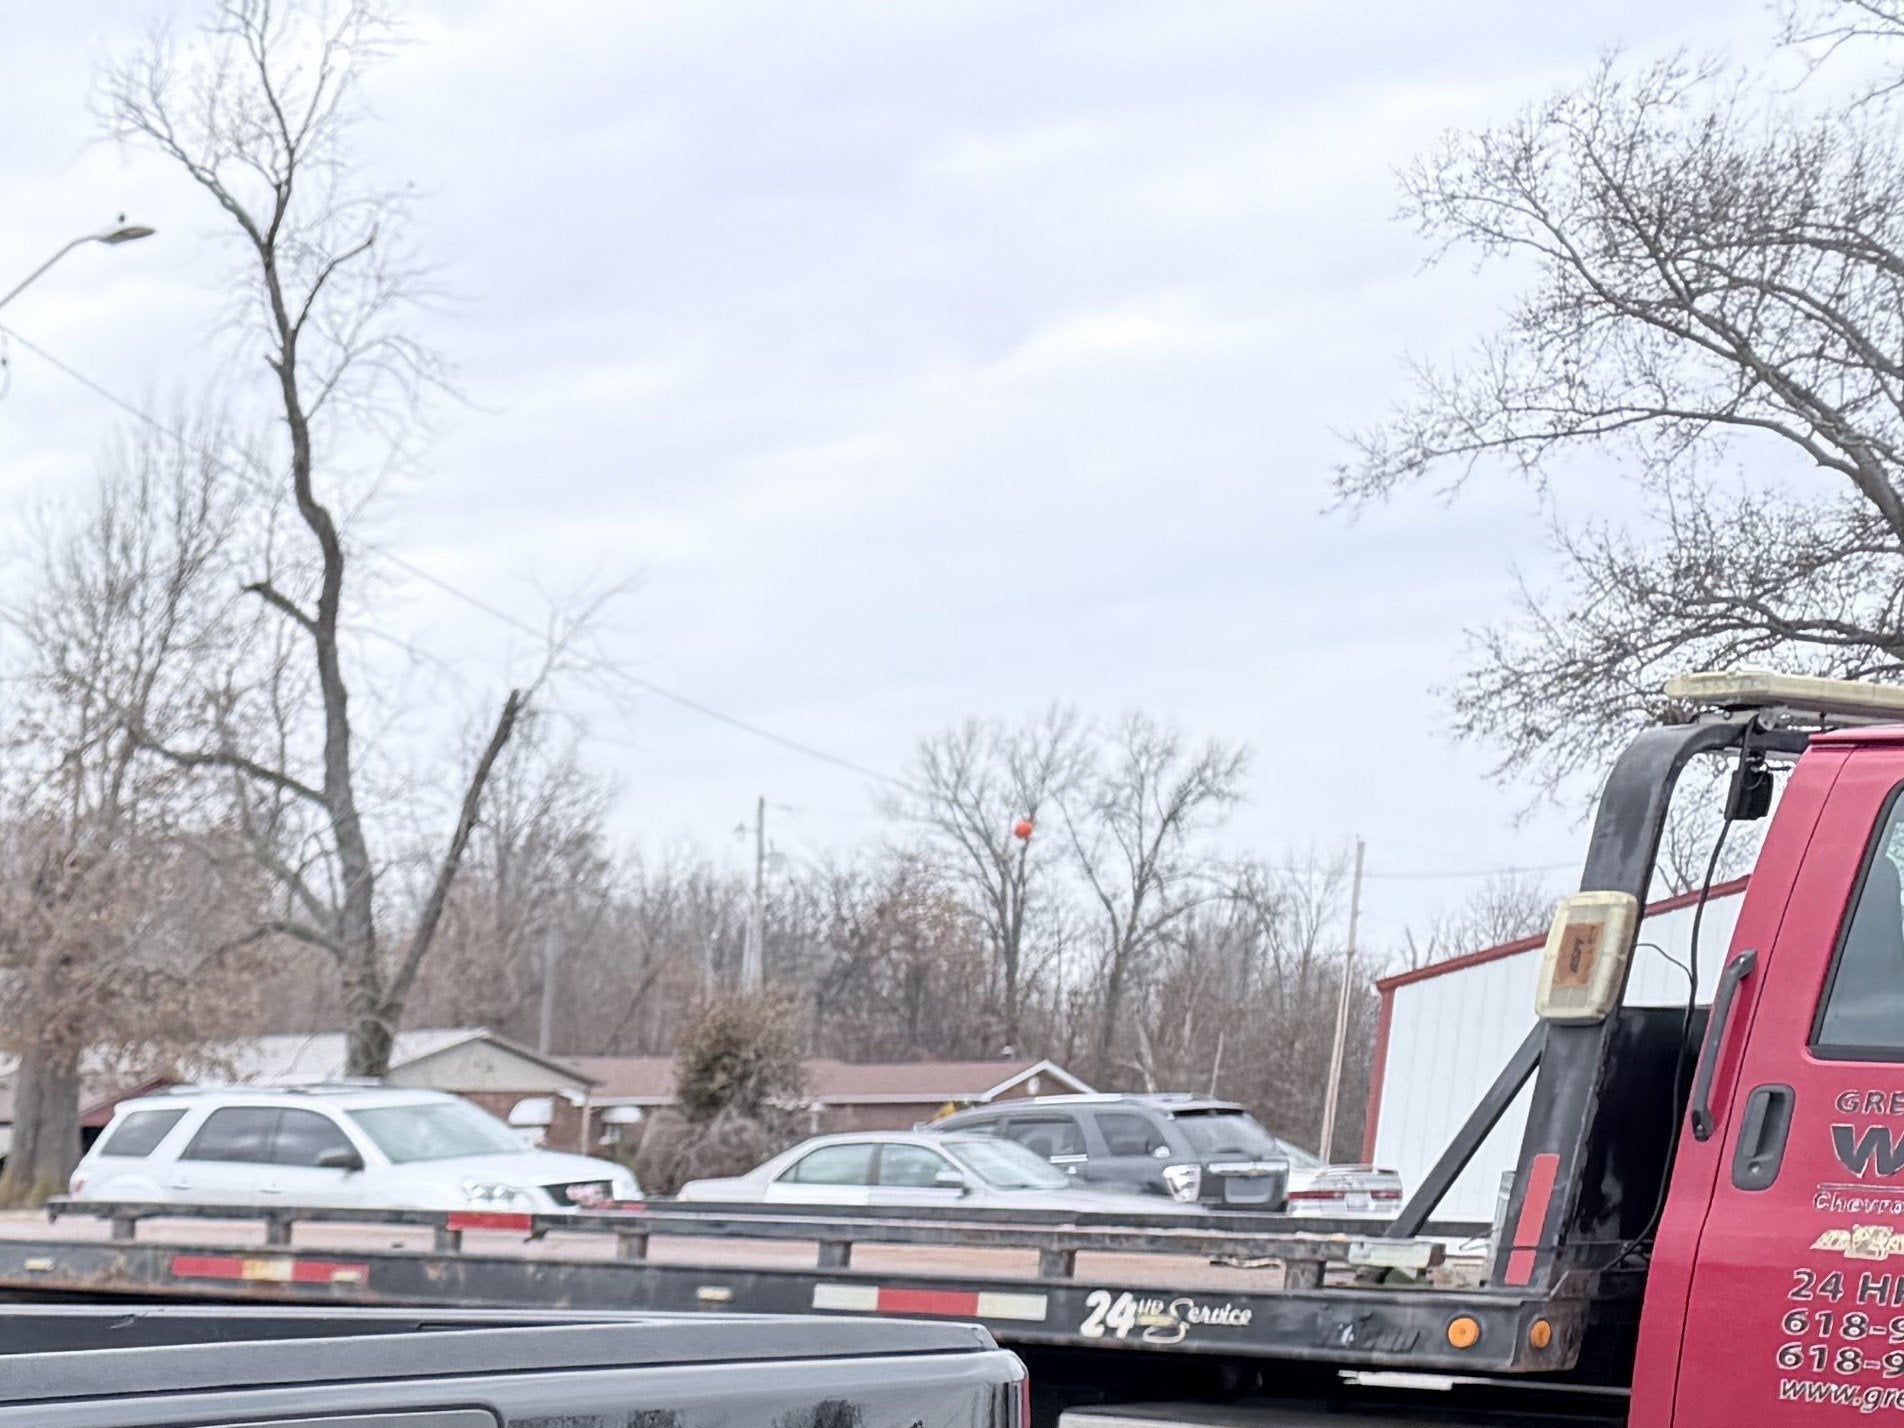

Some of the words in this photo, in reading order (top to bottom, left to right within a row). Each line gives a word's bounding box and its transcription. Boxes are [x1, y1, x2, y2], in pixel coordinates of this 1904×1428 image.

[1787, 1267, 1844, 1303] 24
[1079, 1289, 1138, 1338] 24
[1142, 1297, 1253, 1345] Service
[1775, 1341, 1904, 1379] 618-9
